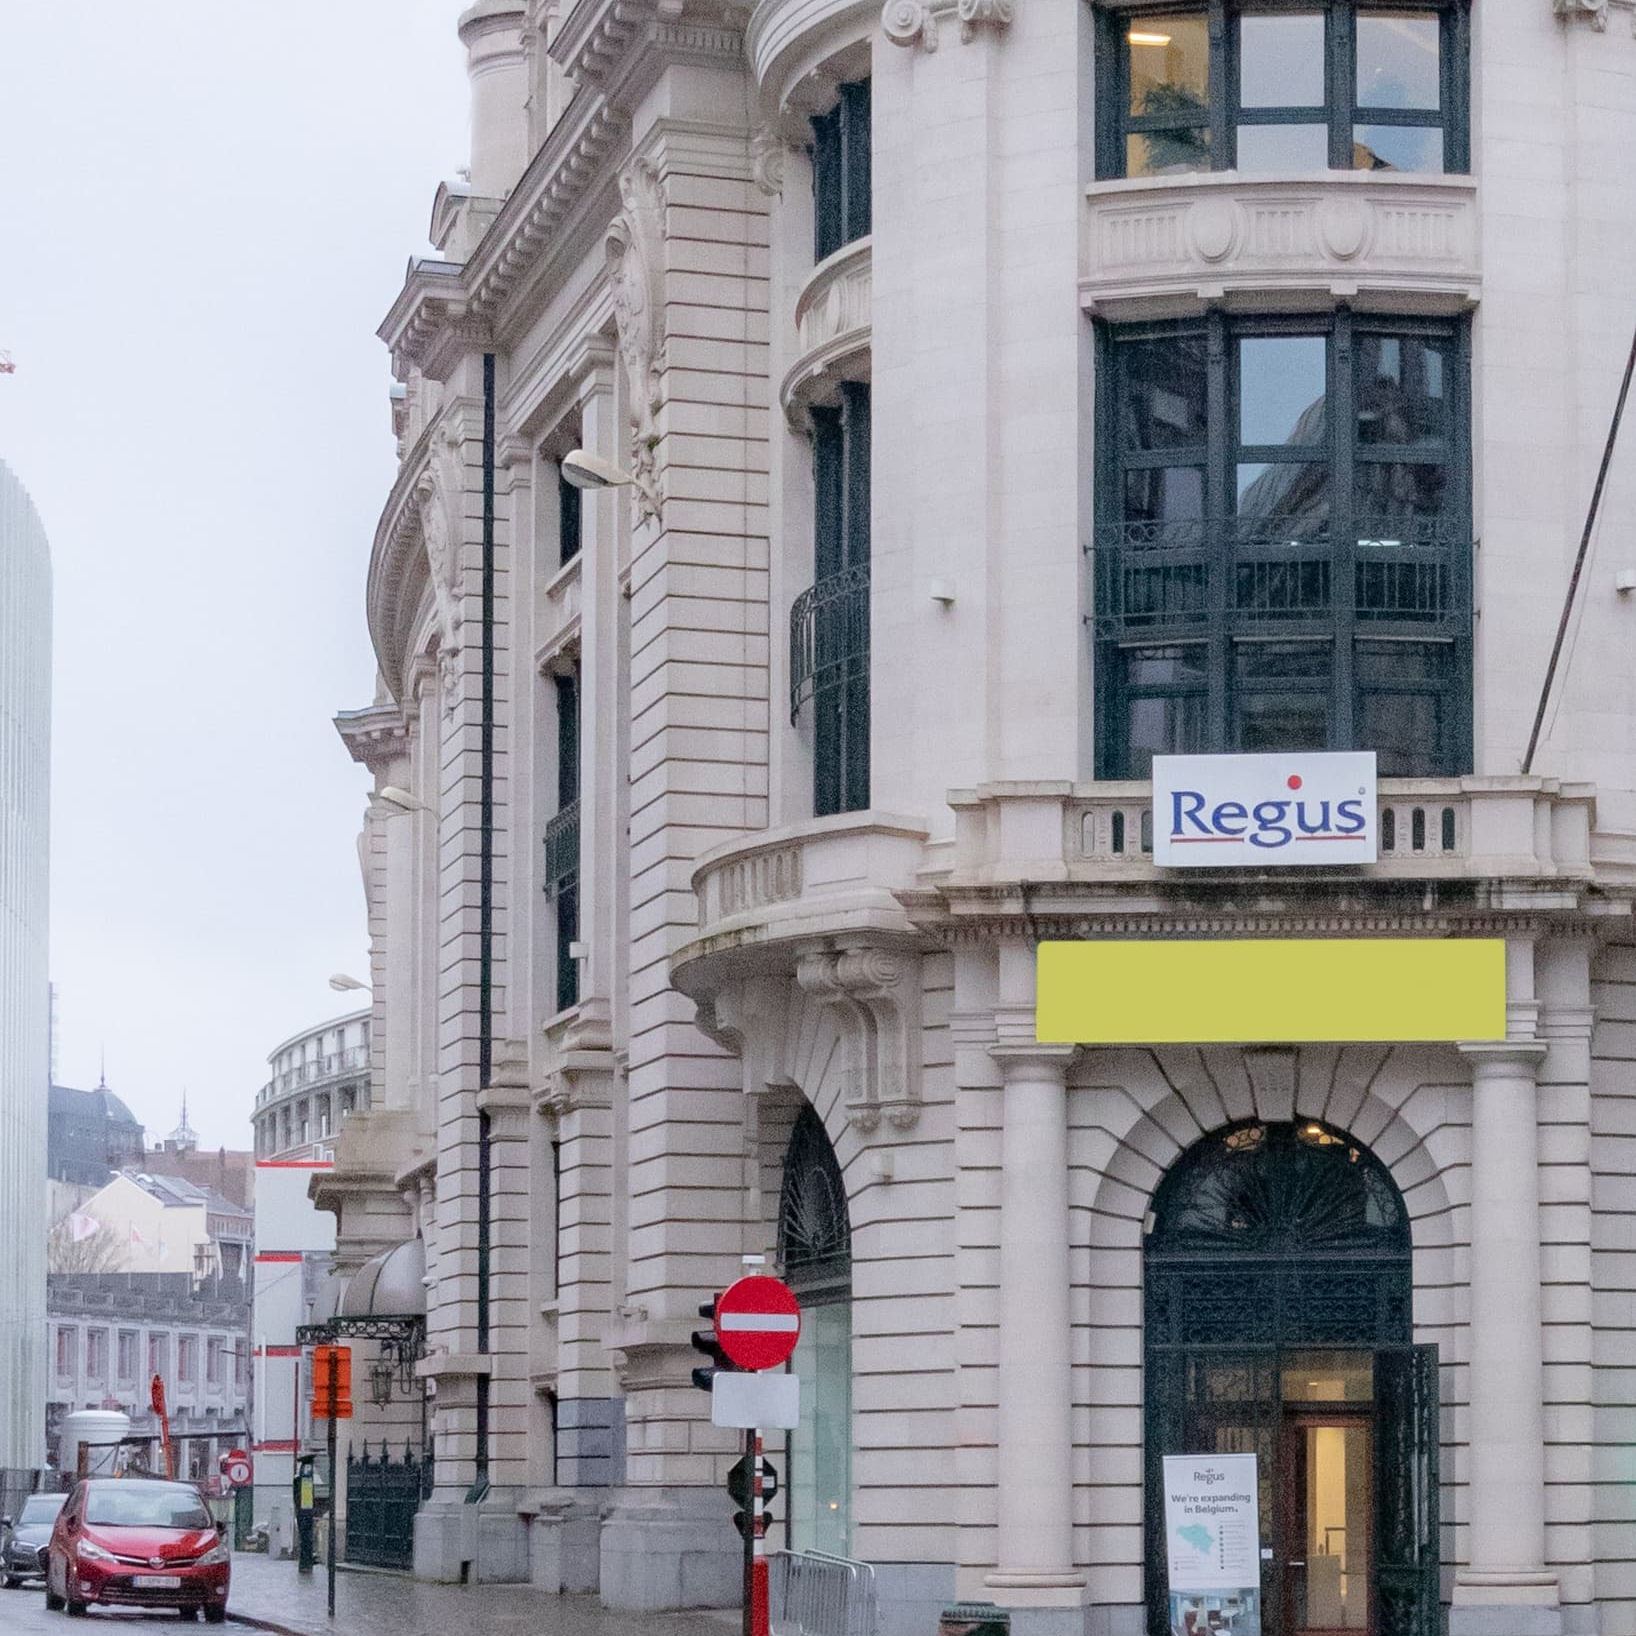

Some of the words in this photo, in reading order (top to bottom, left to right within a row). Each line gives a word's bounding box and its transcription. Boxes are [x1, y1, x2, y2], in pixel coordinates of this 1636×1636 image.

[1170, 790, 1366, 848] Regus
[1193, 1470, 1225, 1485] Regus
[1171, 1494, 1199, 1503] We're
[1200, 1493, 1251, 1503] expanding
[1184, 1505, 1193, 1514] in
[1195, 1505, 1239, 1515] Belgium.
